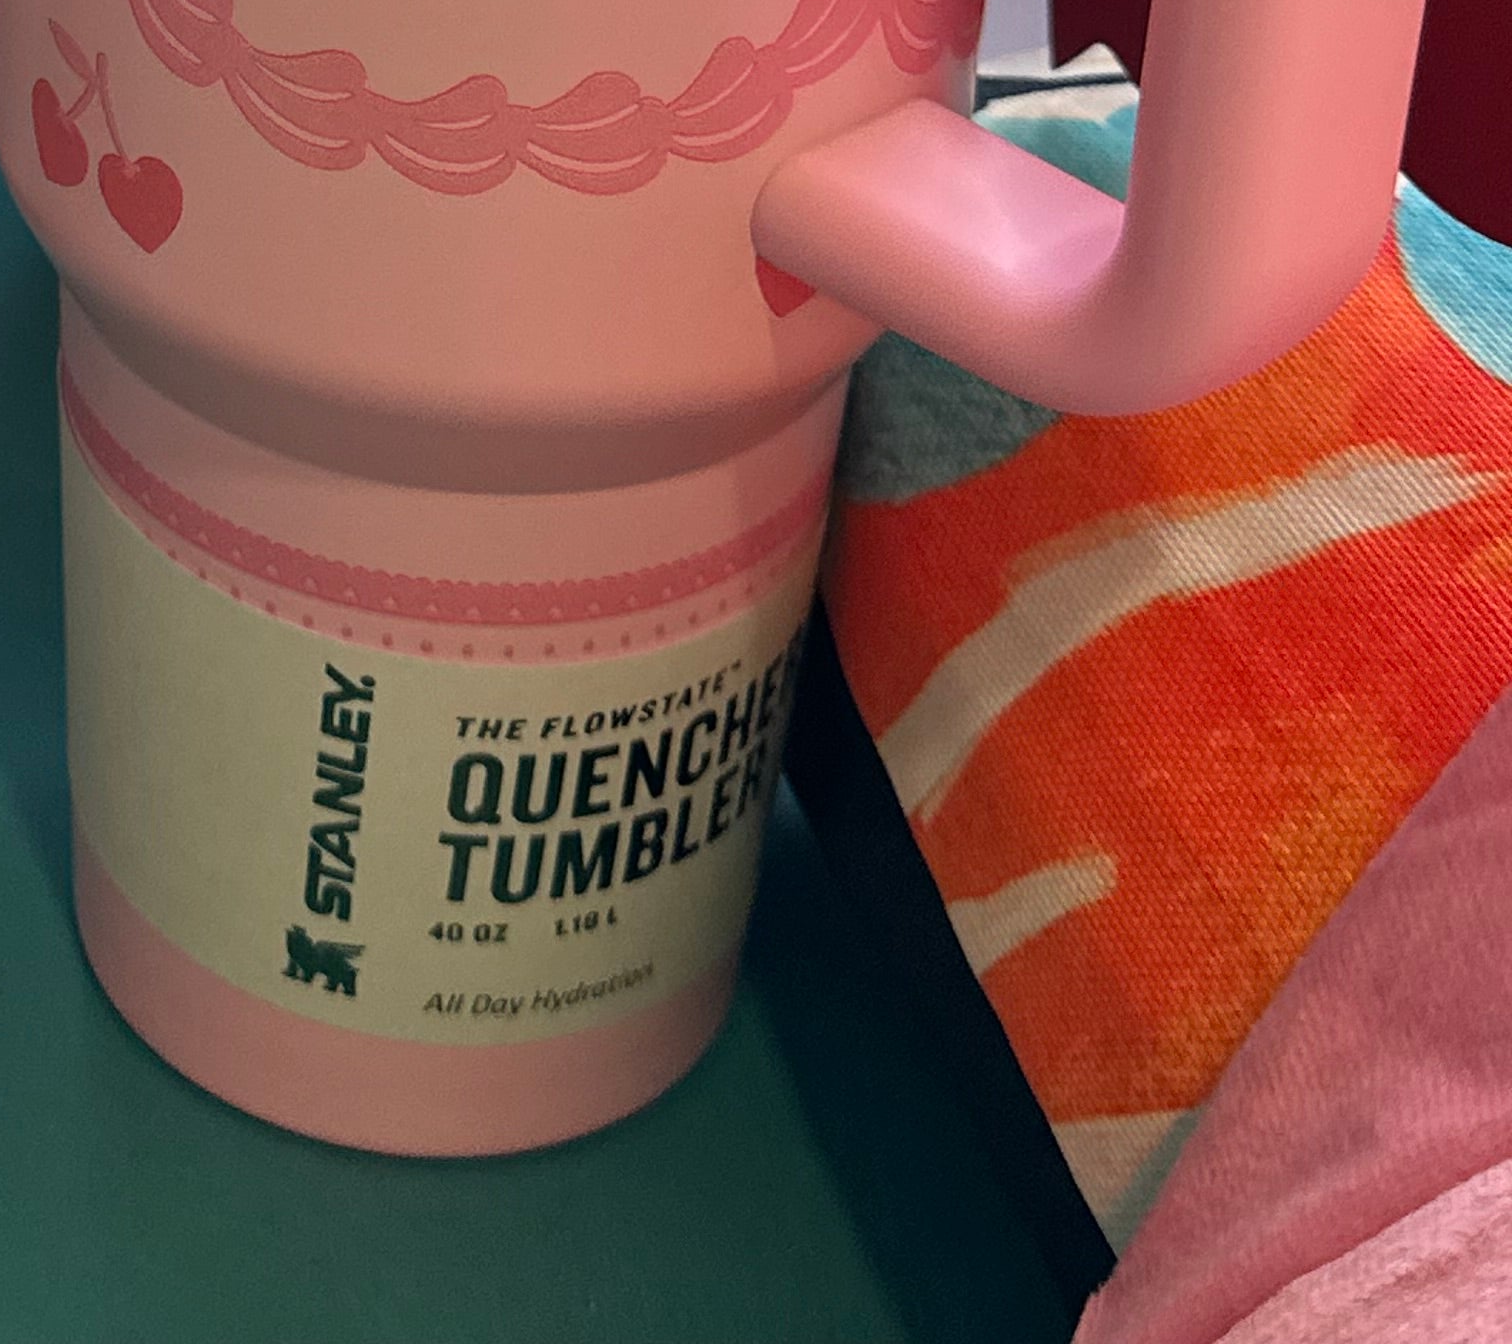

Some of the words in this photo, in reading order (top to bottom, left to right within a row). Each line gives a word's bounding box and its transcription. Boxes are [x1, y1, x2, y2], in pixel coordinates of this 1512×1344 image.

[455, 715, 523, 741] THE
[438, 737, 767, 905] TUMBLER
[429, 921, 463, 943] 40
[473, 922, 509, 943] OZ
[423, 992, 465, 1013] All
[471, 992, 524, 1019] Day
